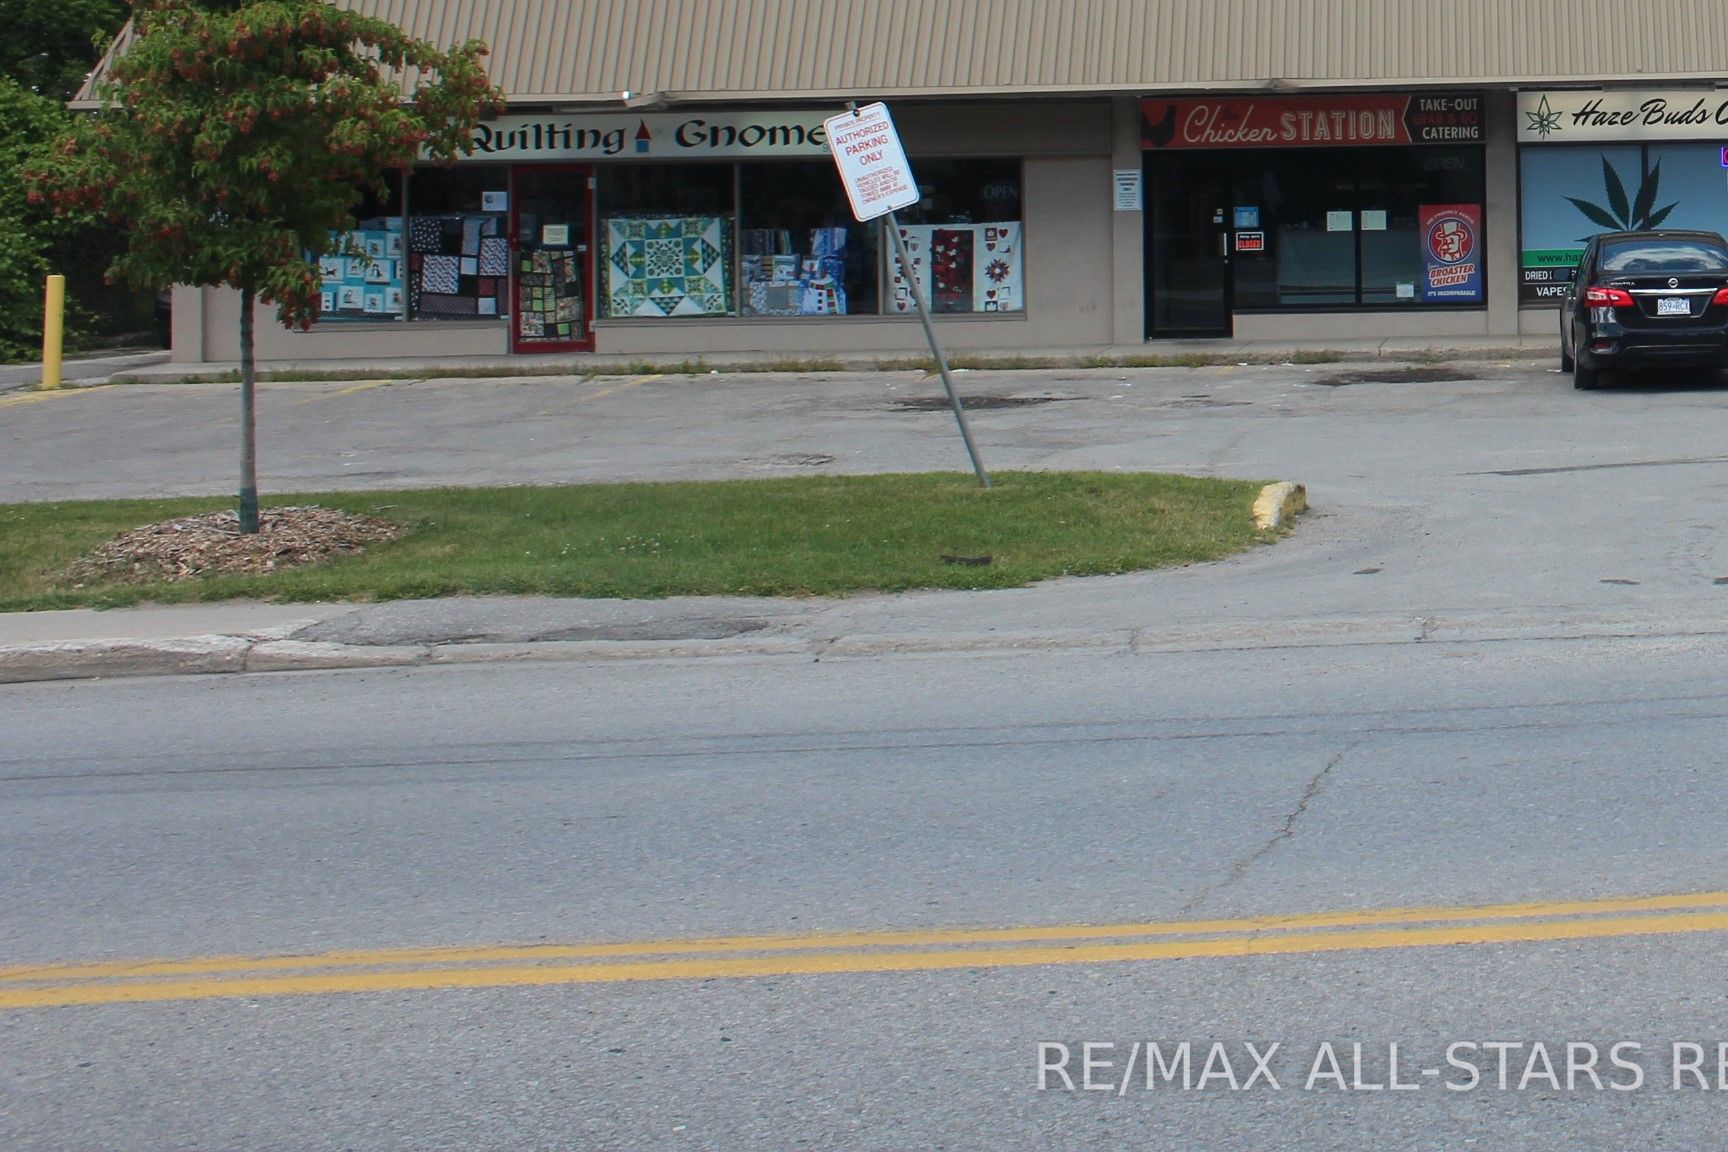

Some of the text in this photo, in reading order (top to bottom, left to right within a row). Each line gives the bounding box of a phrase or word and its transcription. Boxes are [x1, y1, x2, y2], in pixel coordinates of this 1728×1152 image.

[1419, 98, 1478, 111] TAKE-OUT
[1572, 99, 1641, 127] Haze
[1640, 98, 1714, 126] Buds
[1183, 104, 1395, 143] Chicken STATION
[471, 119, 827, 156] Quilting Gnome
[836, 121, 889, 145] AUTHORIZED
[1422, 126, 1479, 139] CATERING
[845, 135, 889, 156] PARKING
[860, 150, 884, 166] ONLY
[1430, 264, 1474, 278] BROASTER
[1525, 271, 1548, 280] DRIED
[1431, 275, 1467, 286] CHICKEN
